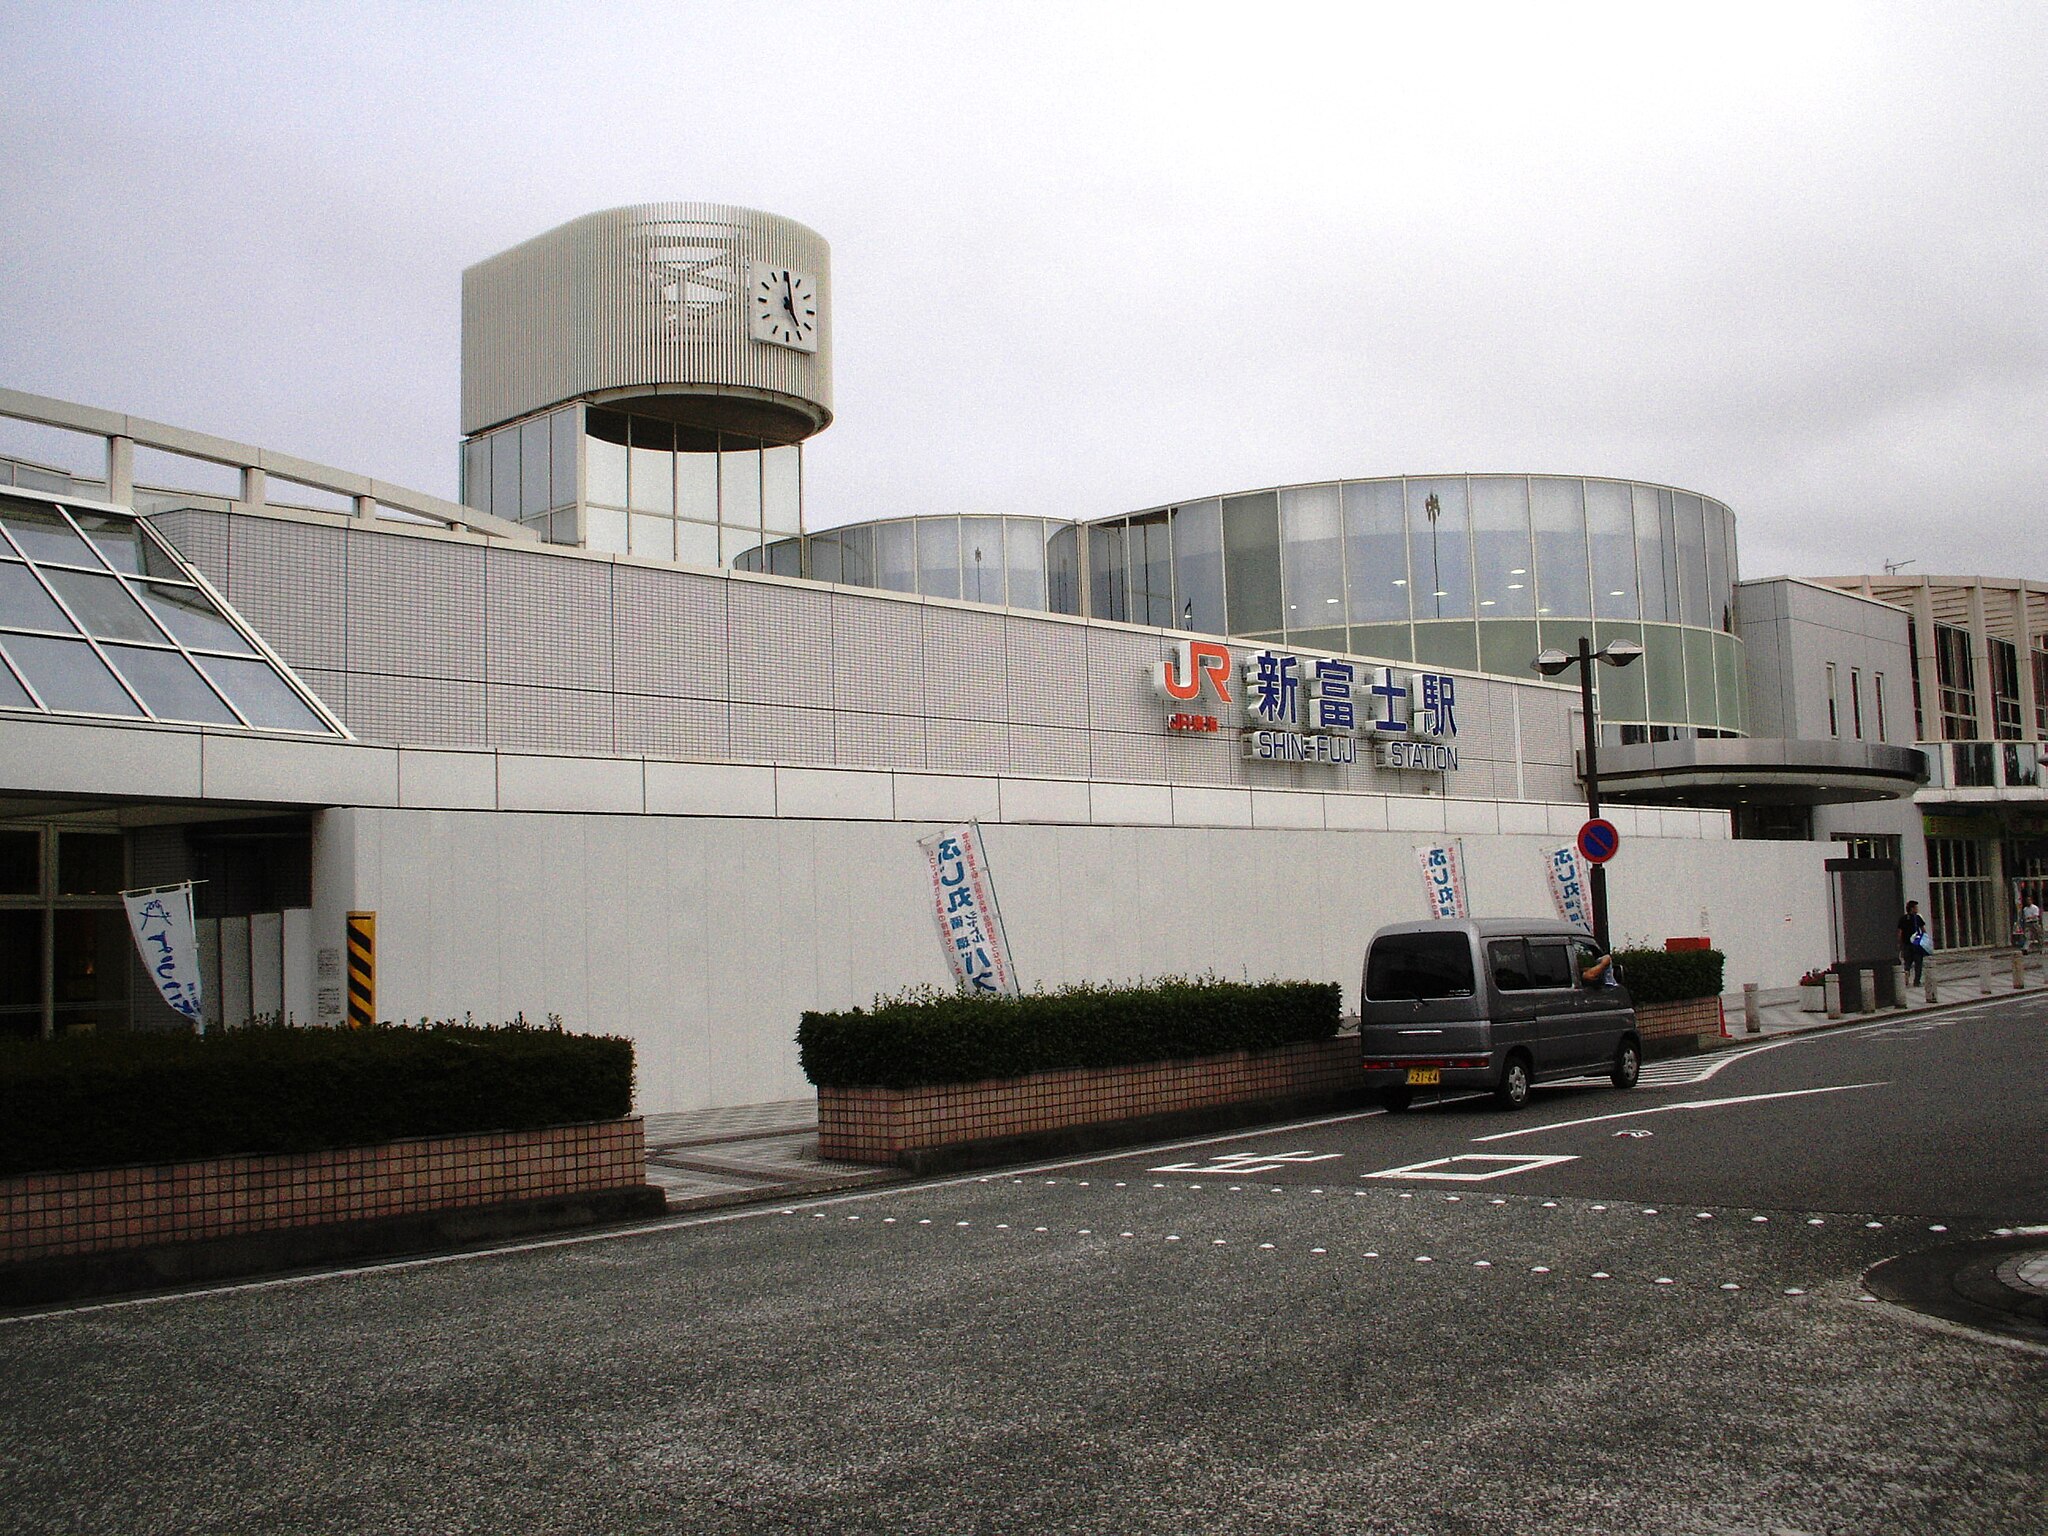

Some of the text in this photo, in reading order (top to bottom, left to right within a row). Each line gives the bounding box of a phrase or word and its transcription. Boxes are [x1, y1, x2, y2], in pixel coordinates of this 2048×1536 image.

[1162, 641, 1233, 703] JR
[1255, 650, 1458, 737] 新富士駅
[1258, 731, 1458, 771] SHIN-FUJI STATION
